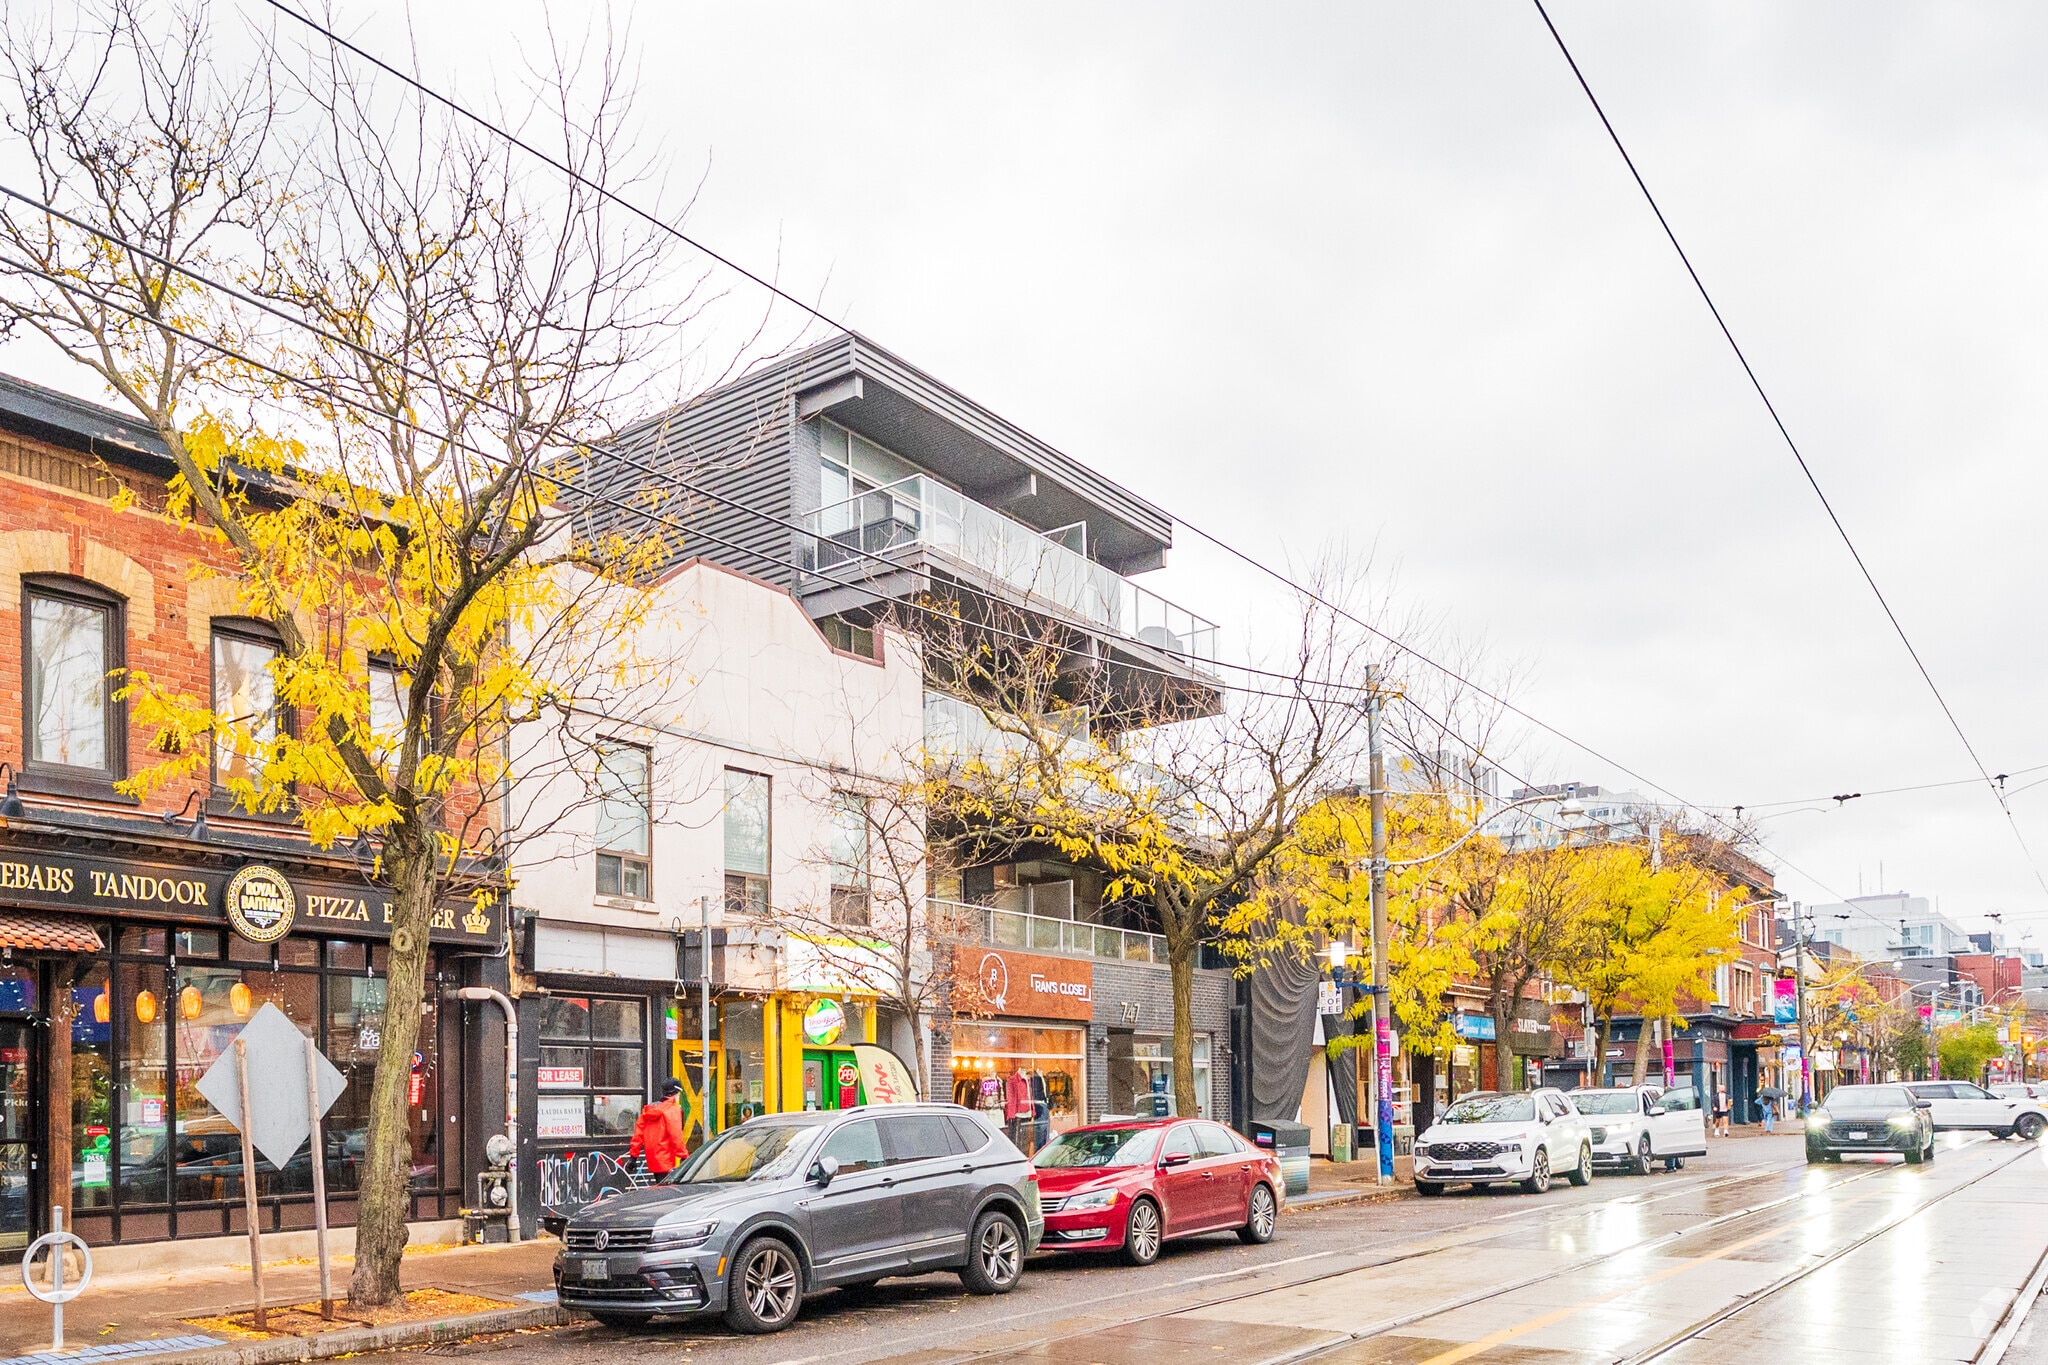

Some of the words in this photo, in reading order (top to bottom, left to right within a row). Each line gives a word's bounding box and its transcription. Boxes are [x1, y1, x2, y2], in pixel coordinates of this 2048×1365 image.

[90, 870, 209, 906] TANDOOR
[246, 882, 279, 898] ROYAL
[306, 895, 370, 921] PIZZA
[383, 902, 456, 929] BER
[1035, 980, 1058, 993] RAN'S
[1059, 983, 1087, 996] CLOSET
[1121, 1002, 1140, 1023] 747
[554, 1071, 579, 1081] LEASE
[86, 1154, 104, 1162] PASS
